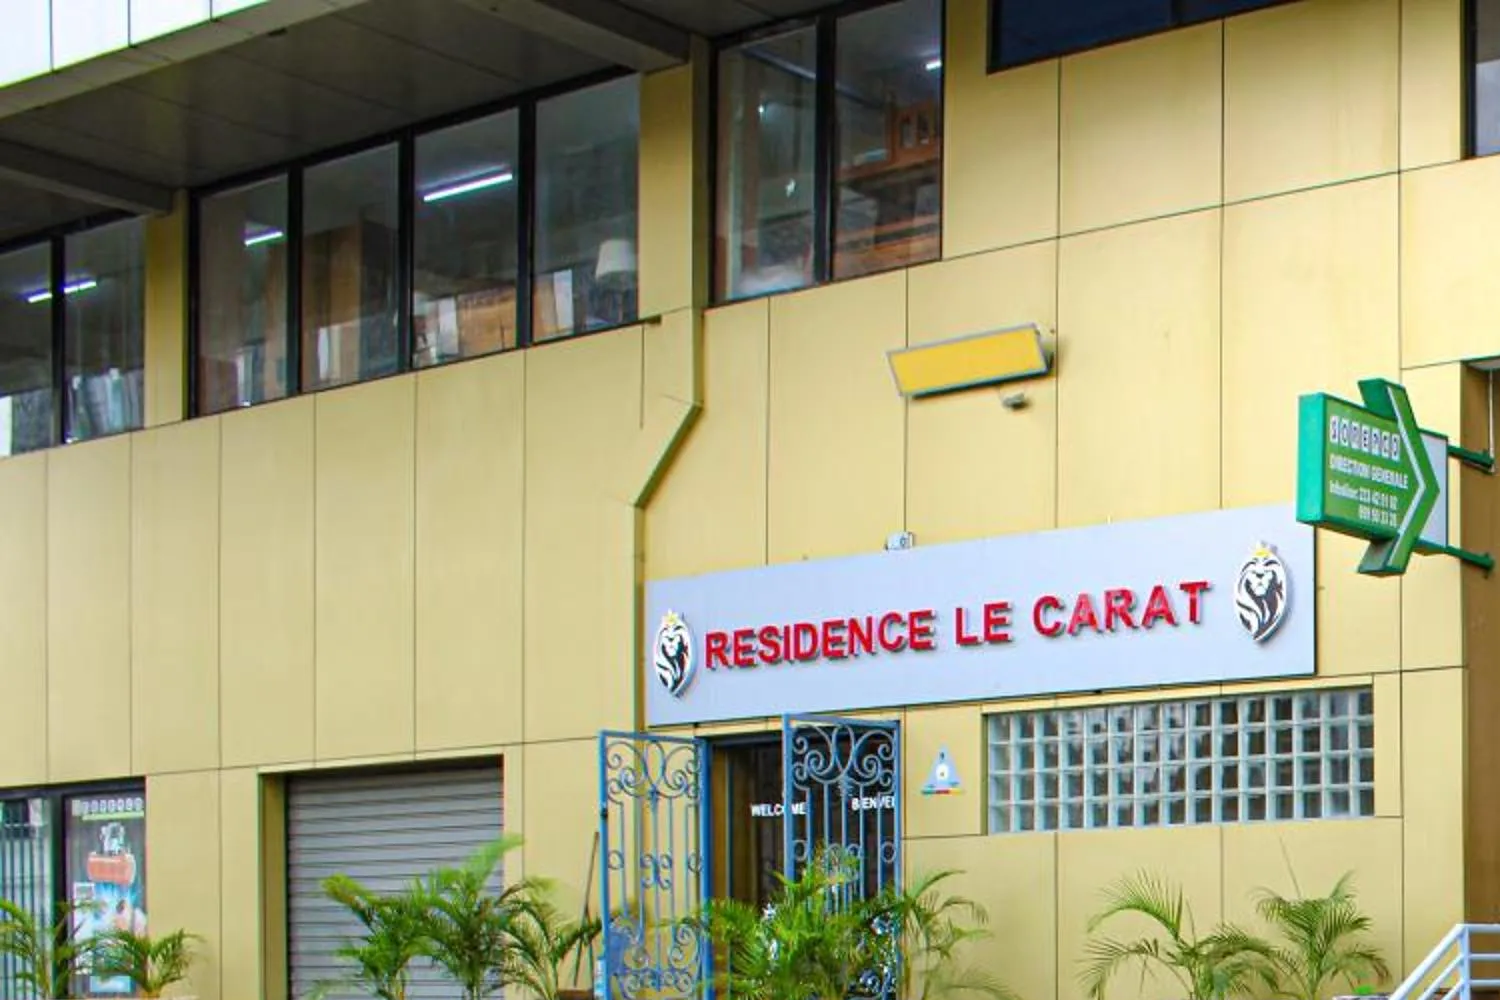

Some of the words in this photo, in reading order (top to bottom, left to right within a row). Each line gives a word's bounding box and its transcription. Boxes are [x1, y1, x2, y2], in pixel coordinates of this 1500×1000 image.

[704, 609, 935, 669] RESIDENCE
[955, 601, 1010, 645] LE
[1032, 580, 1210, 637] CARAT
[751, 802, 807, 817] WELCME
